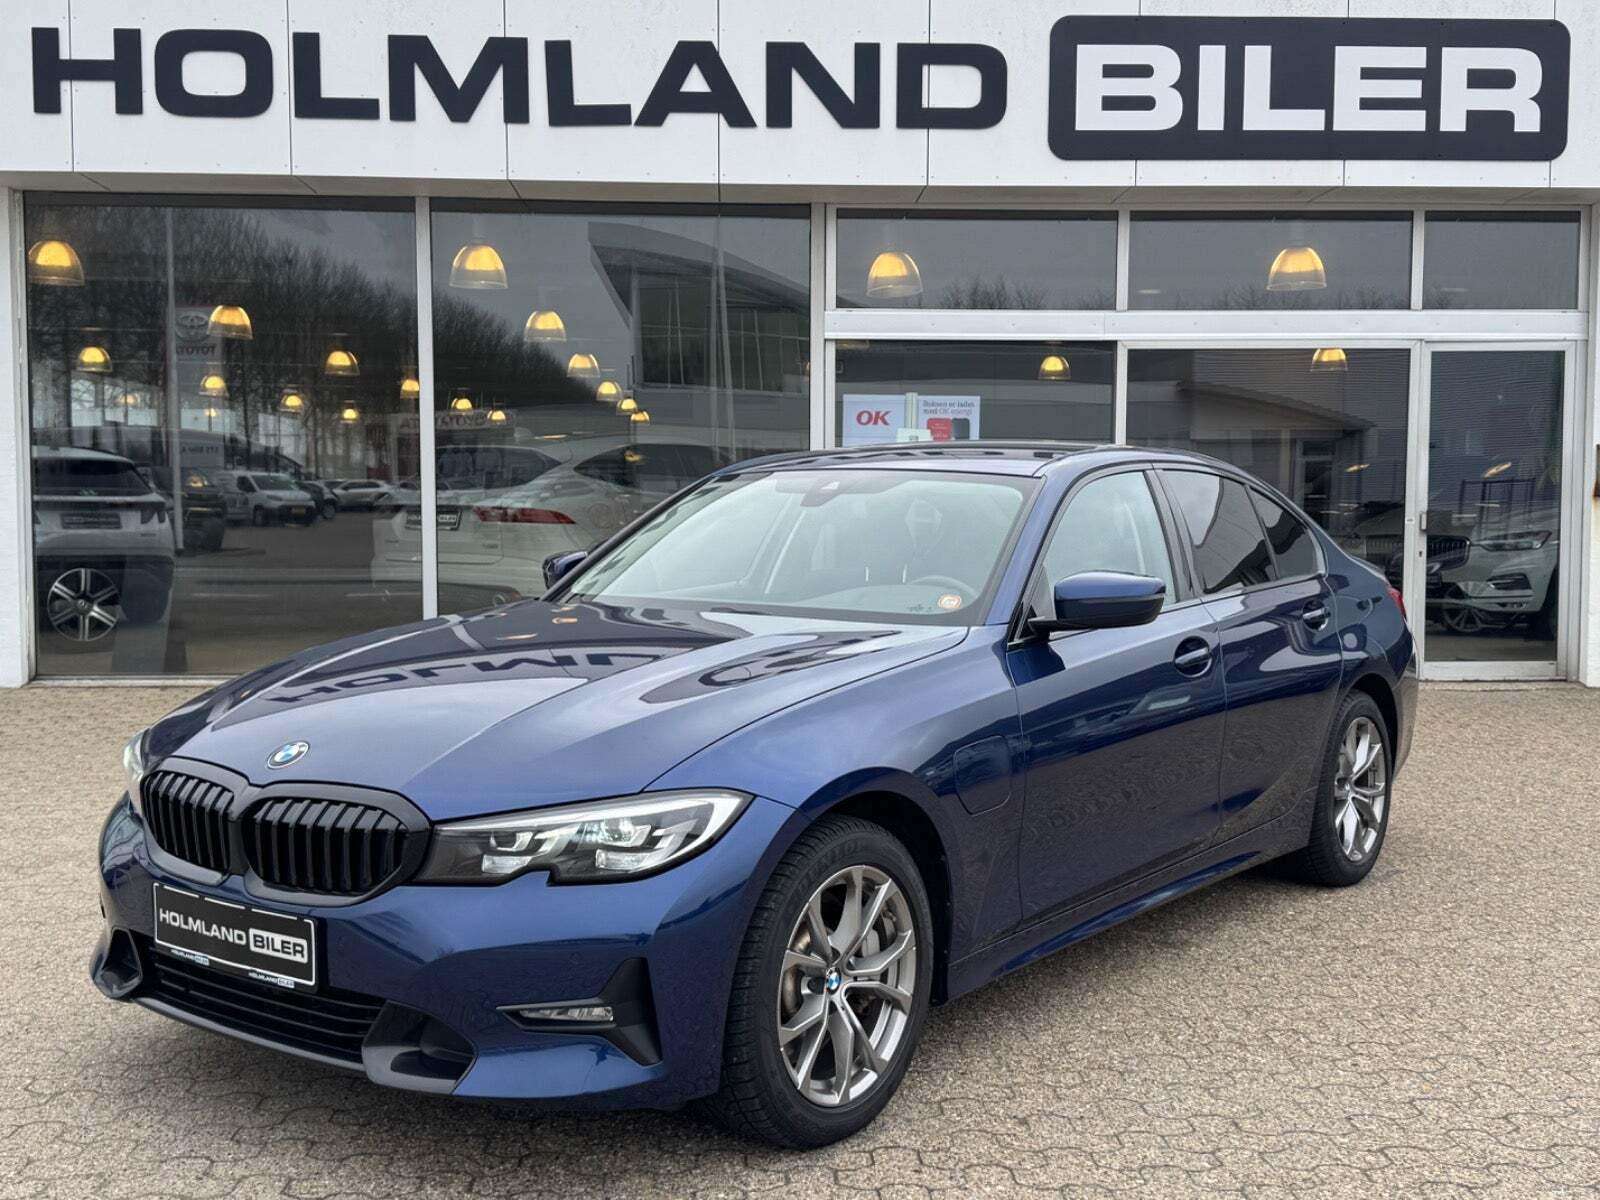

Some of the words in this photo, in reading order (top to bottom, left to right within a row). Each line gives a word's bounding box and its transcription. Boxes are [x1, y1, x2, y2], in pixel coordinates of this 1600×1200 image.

[31, 26, 1009, 130] HOLMLAND
[1075, 43, 1543, 133] BILER
[855, 410, 892, 426] OK
[159, 908, 247, 946] HOLMLAND
[254, 934, 306, 959] BILER
